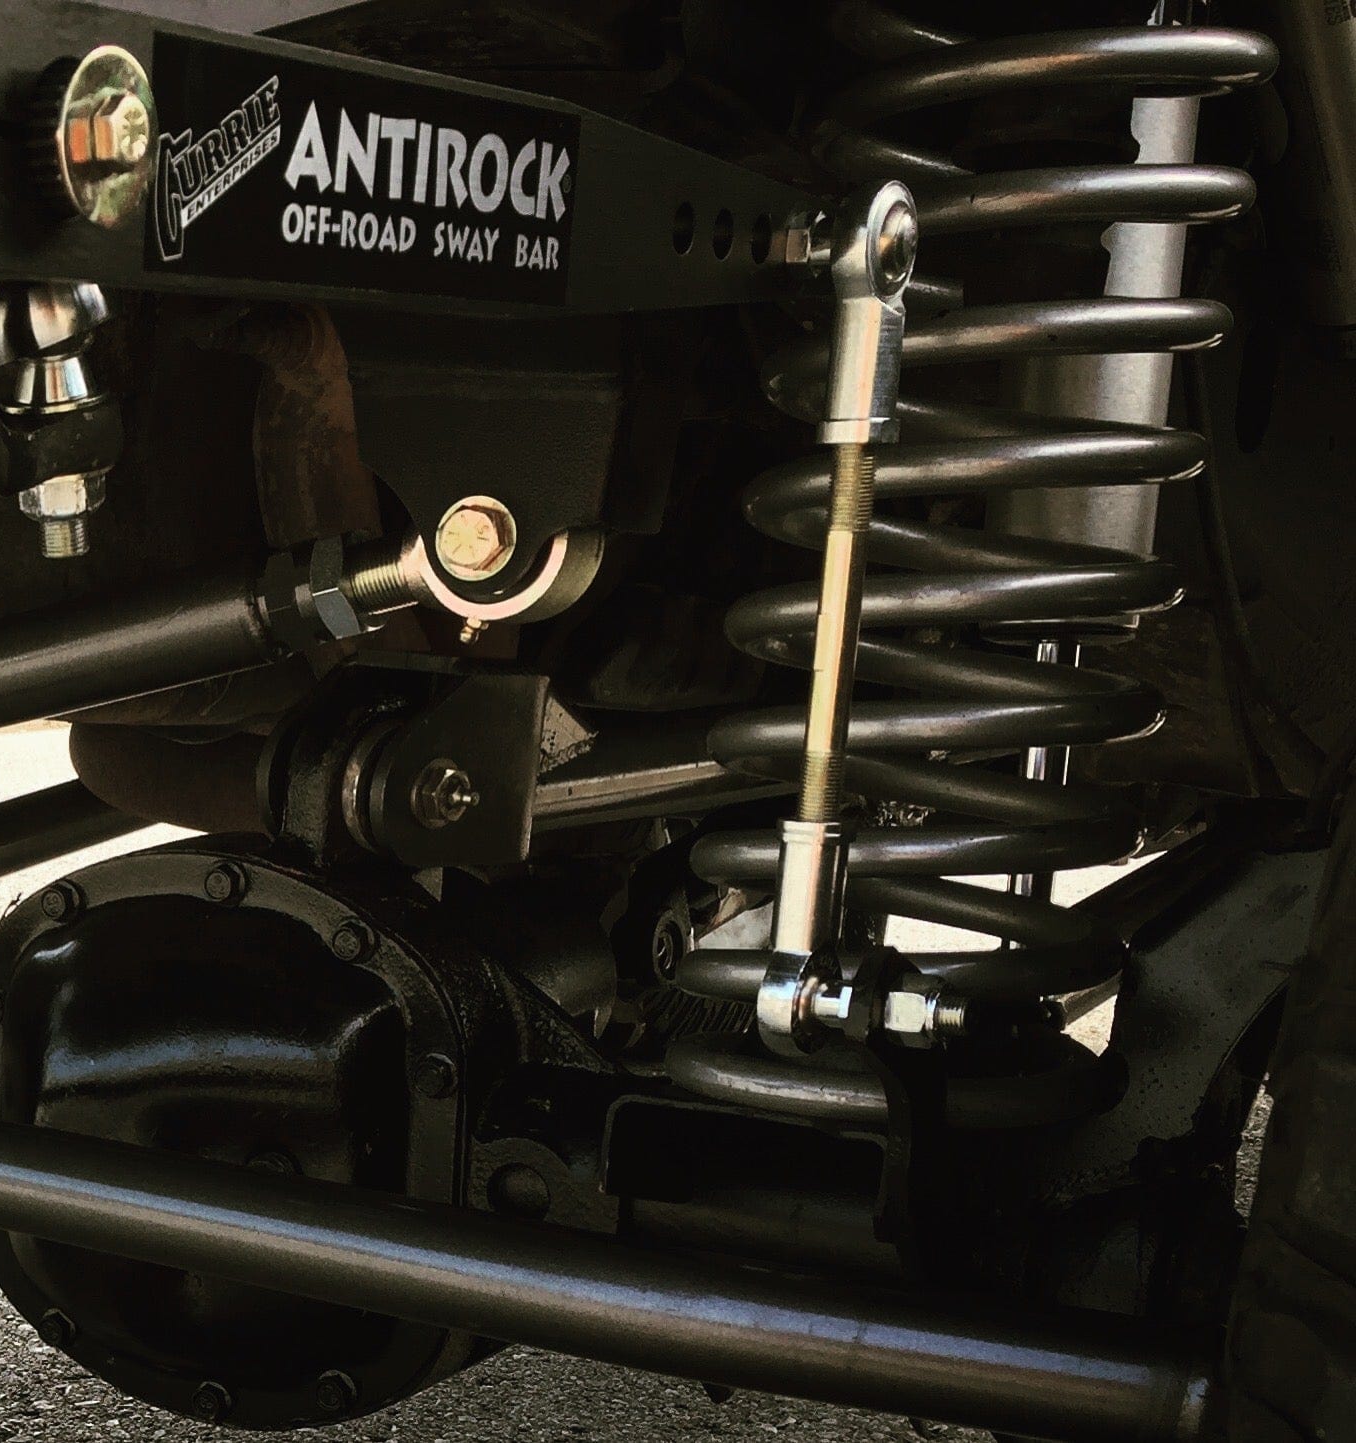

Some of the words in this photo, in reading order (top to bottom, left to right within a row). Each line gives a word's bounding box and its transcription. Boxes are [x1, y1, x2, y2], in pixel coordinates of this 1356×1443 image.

[155, 74, 282, 262] CURRIE
[186, 129, 280, 220] ENTERPRISES
[282, 98, 570, 223] ANTIROCK
[281, 202, 417, 253] OFF-ROAD
[433, 220, 500, 263] SWAY
[514, 233, 560, 271] BAR
